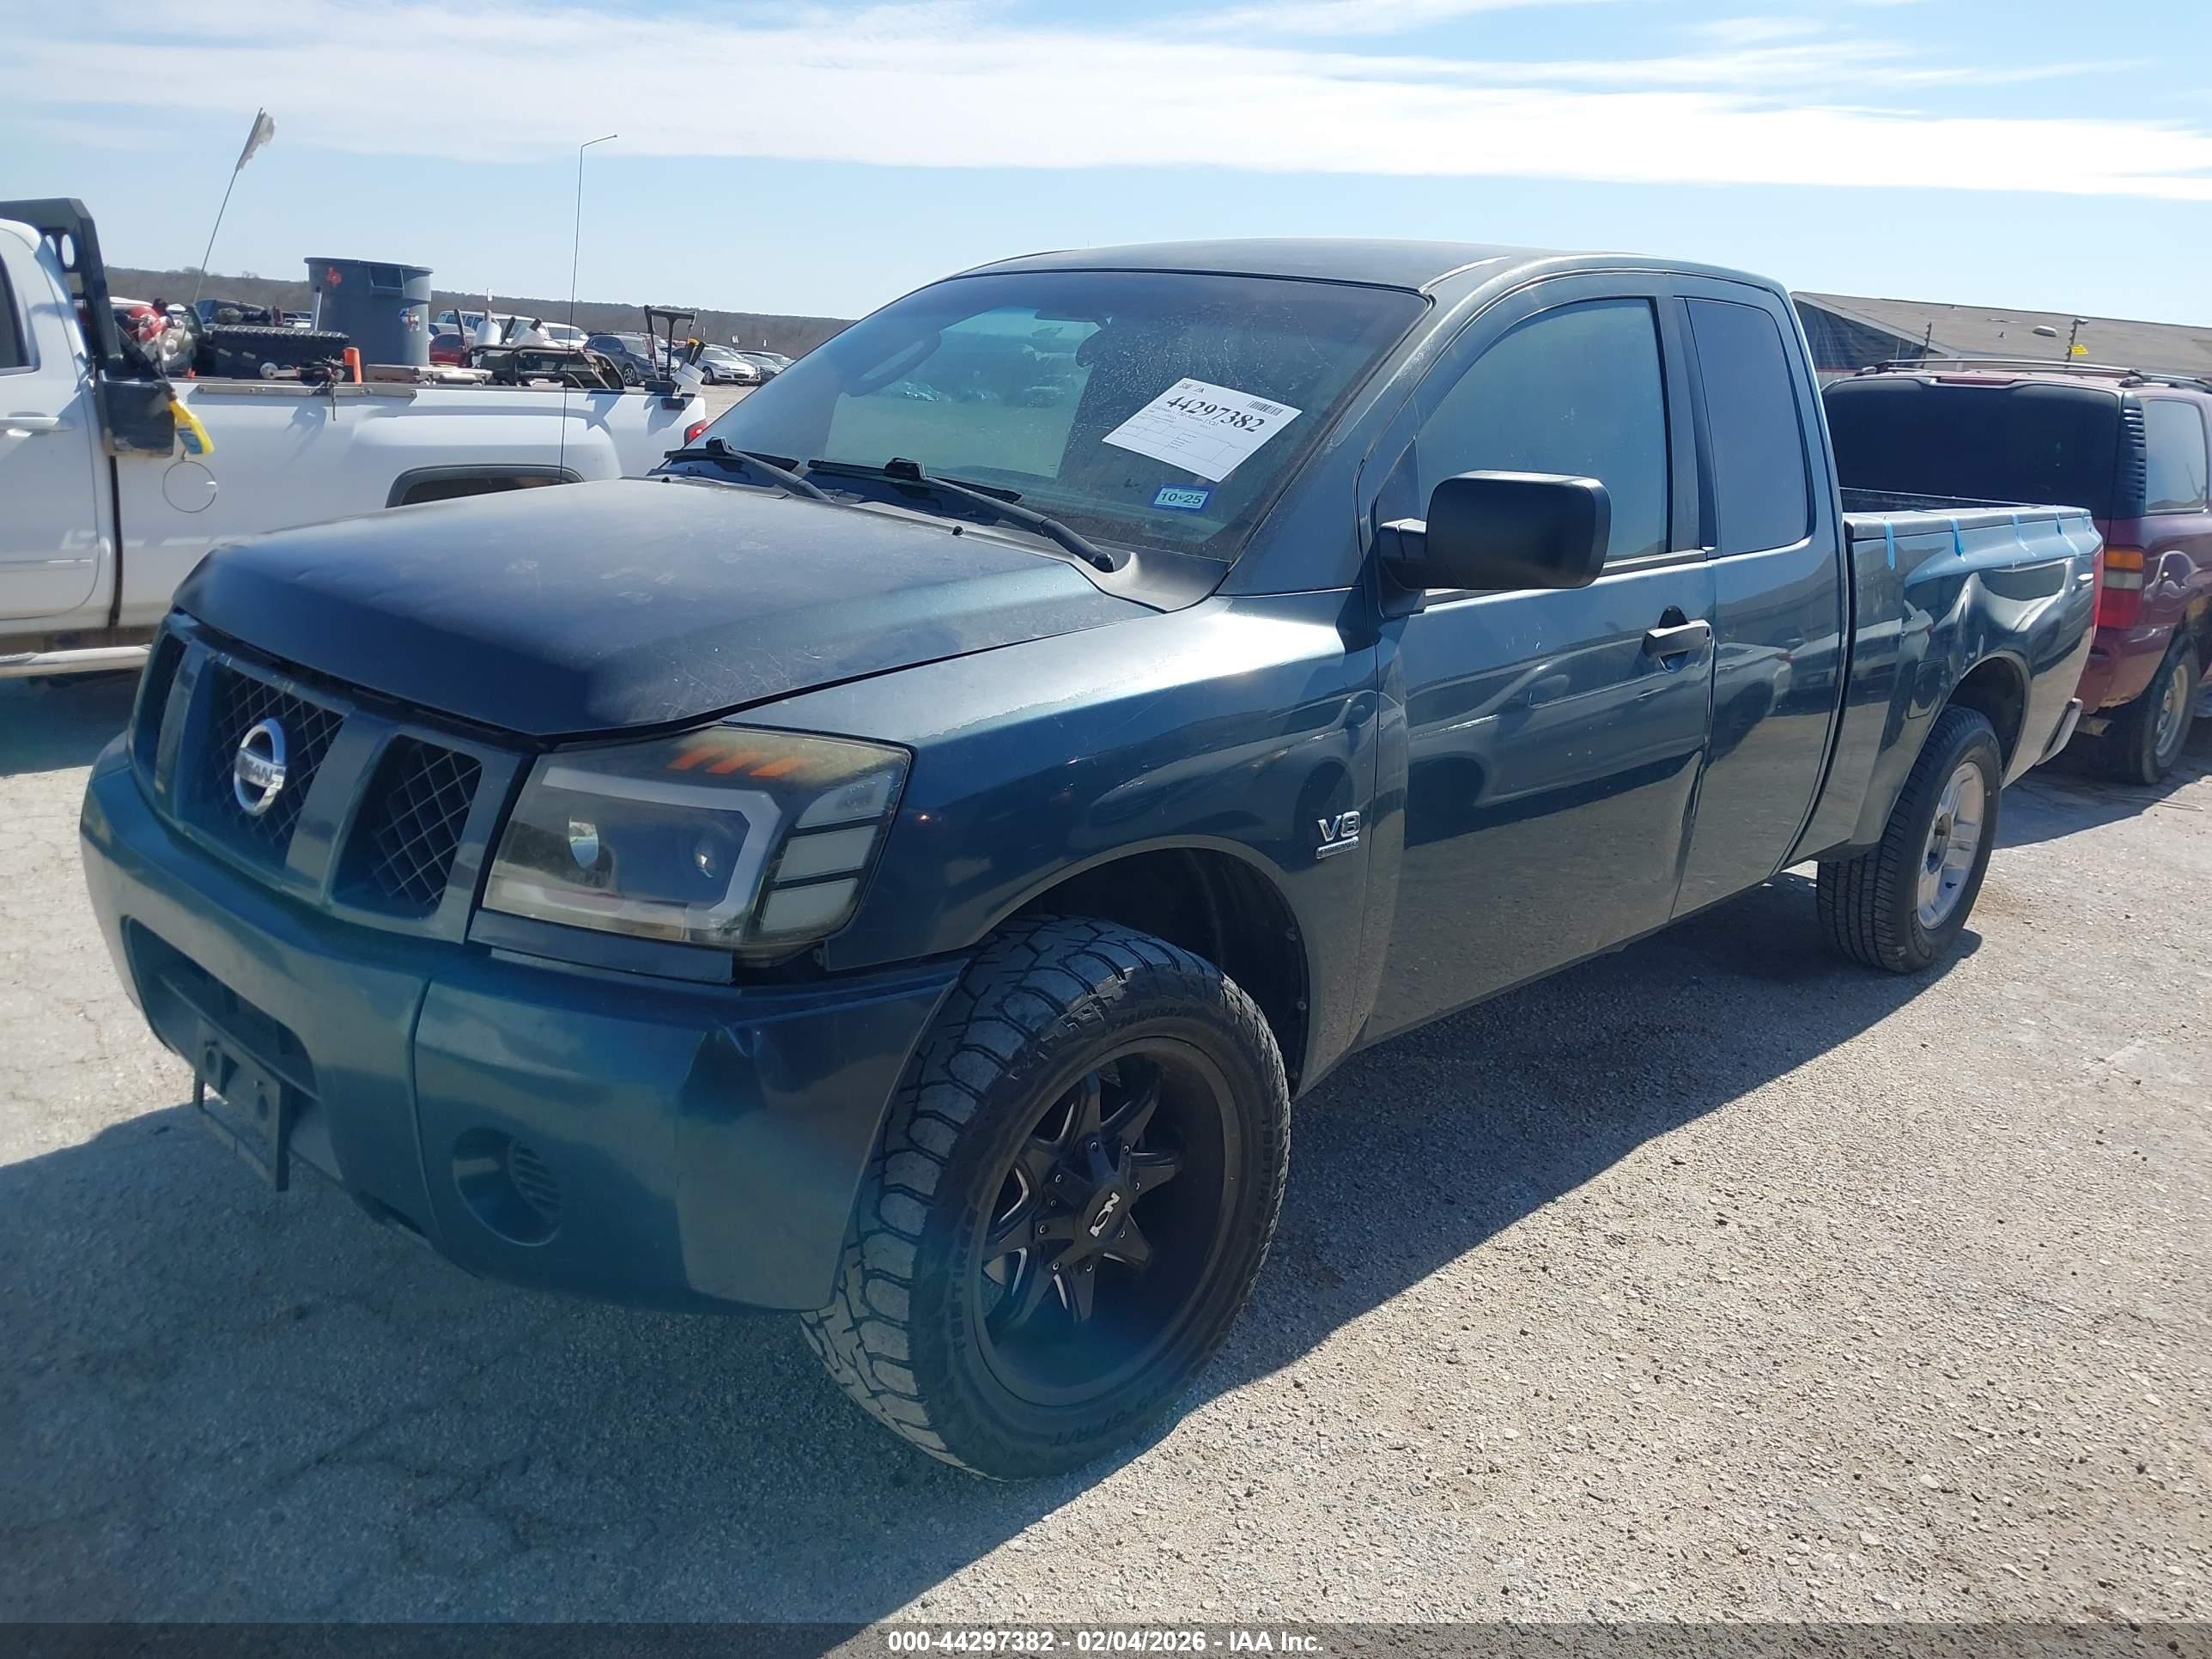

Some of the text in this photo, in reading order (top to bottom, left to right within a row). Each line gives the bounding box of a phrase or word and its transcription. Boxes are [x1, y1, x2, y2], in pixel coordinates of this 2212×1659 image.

[1166, 396, 1266, 433] 44297382
[1317, 811, 1361, 842] V8
[1089, 1192, 1121, 1237] ION
